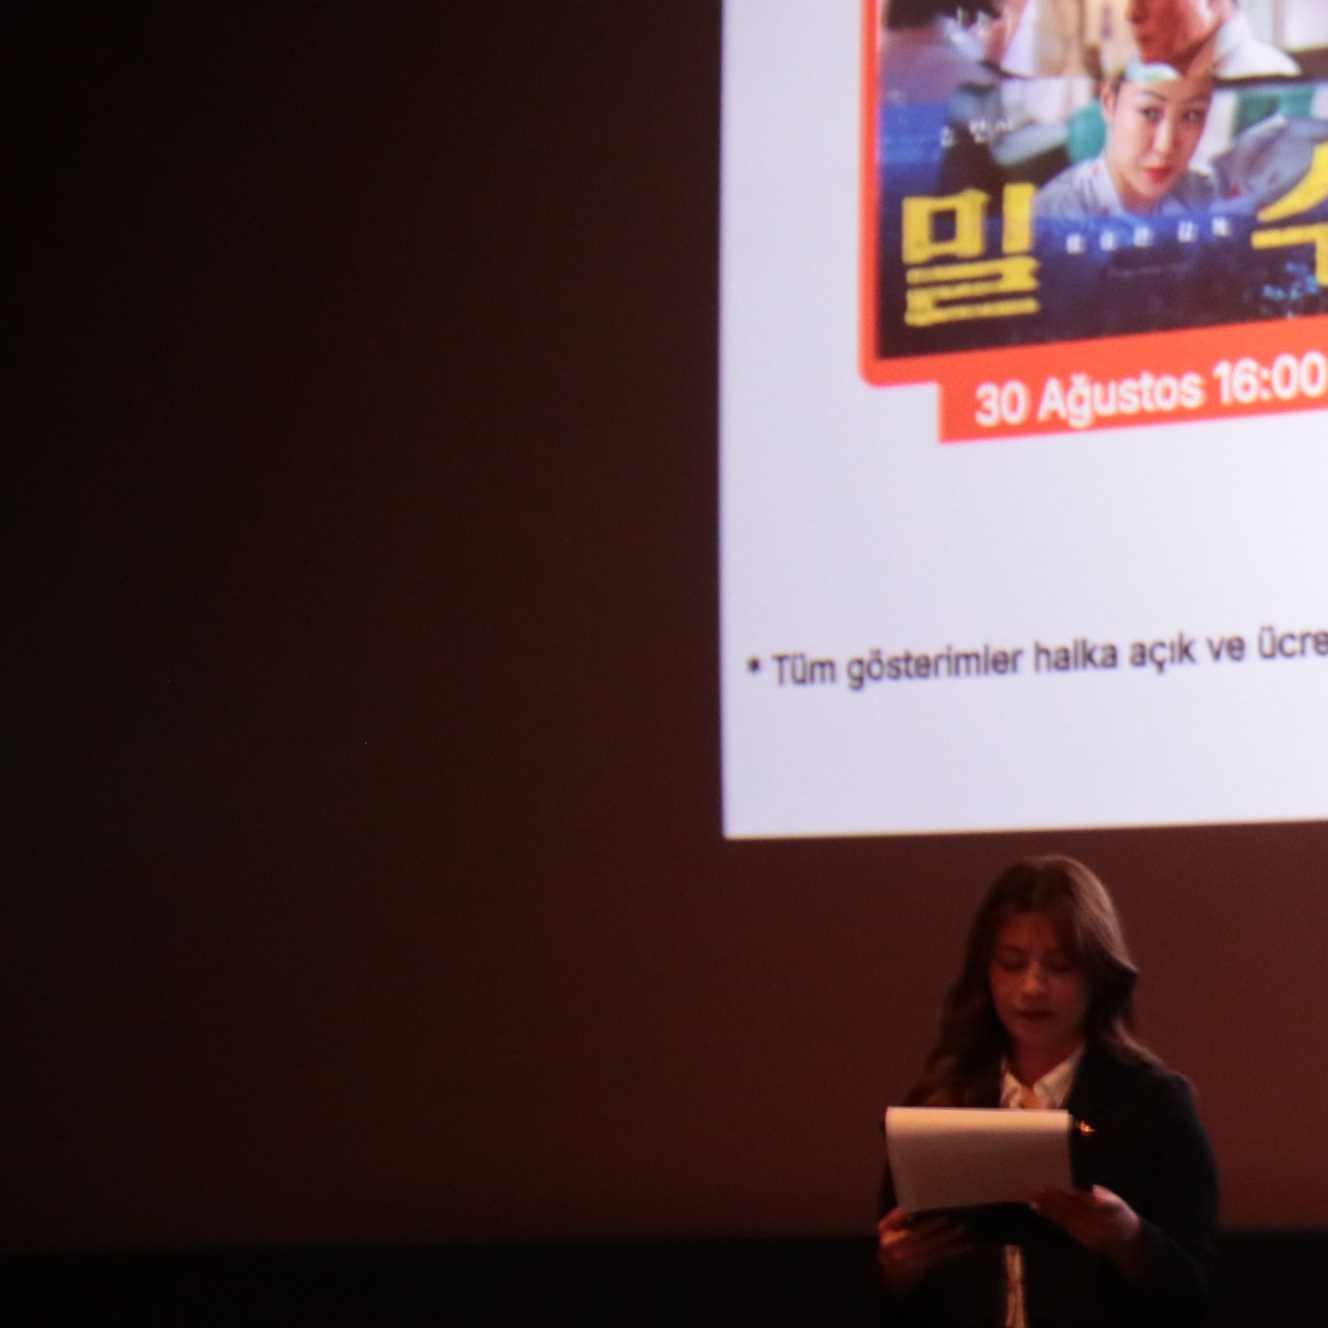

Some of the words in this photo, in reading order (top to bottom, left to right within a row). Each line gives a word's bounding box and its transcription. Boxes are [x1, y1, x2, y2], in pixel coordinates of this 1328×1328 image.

[974, 378, 1028, 429] 30
[1036, 366, 1203, 431] Ağustos
[771, 652, 838, 688] Tüm
[845, 643, 1025, 693] gösterimler
[1032, 637, 1120, 674] halka
[1129, 632, 1198, 676] açık
[1205, 634, 1248, 664] ve
